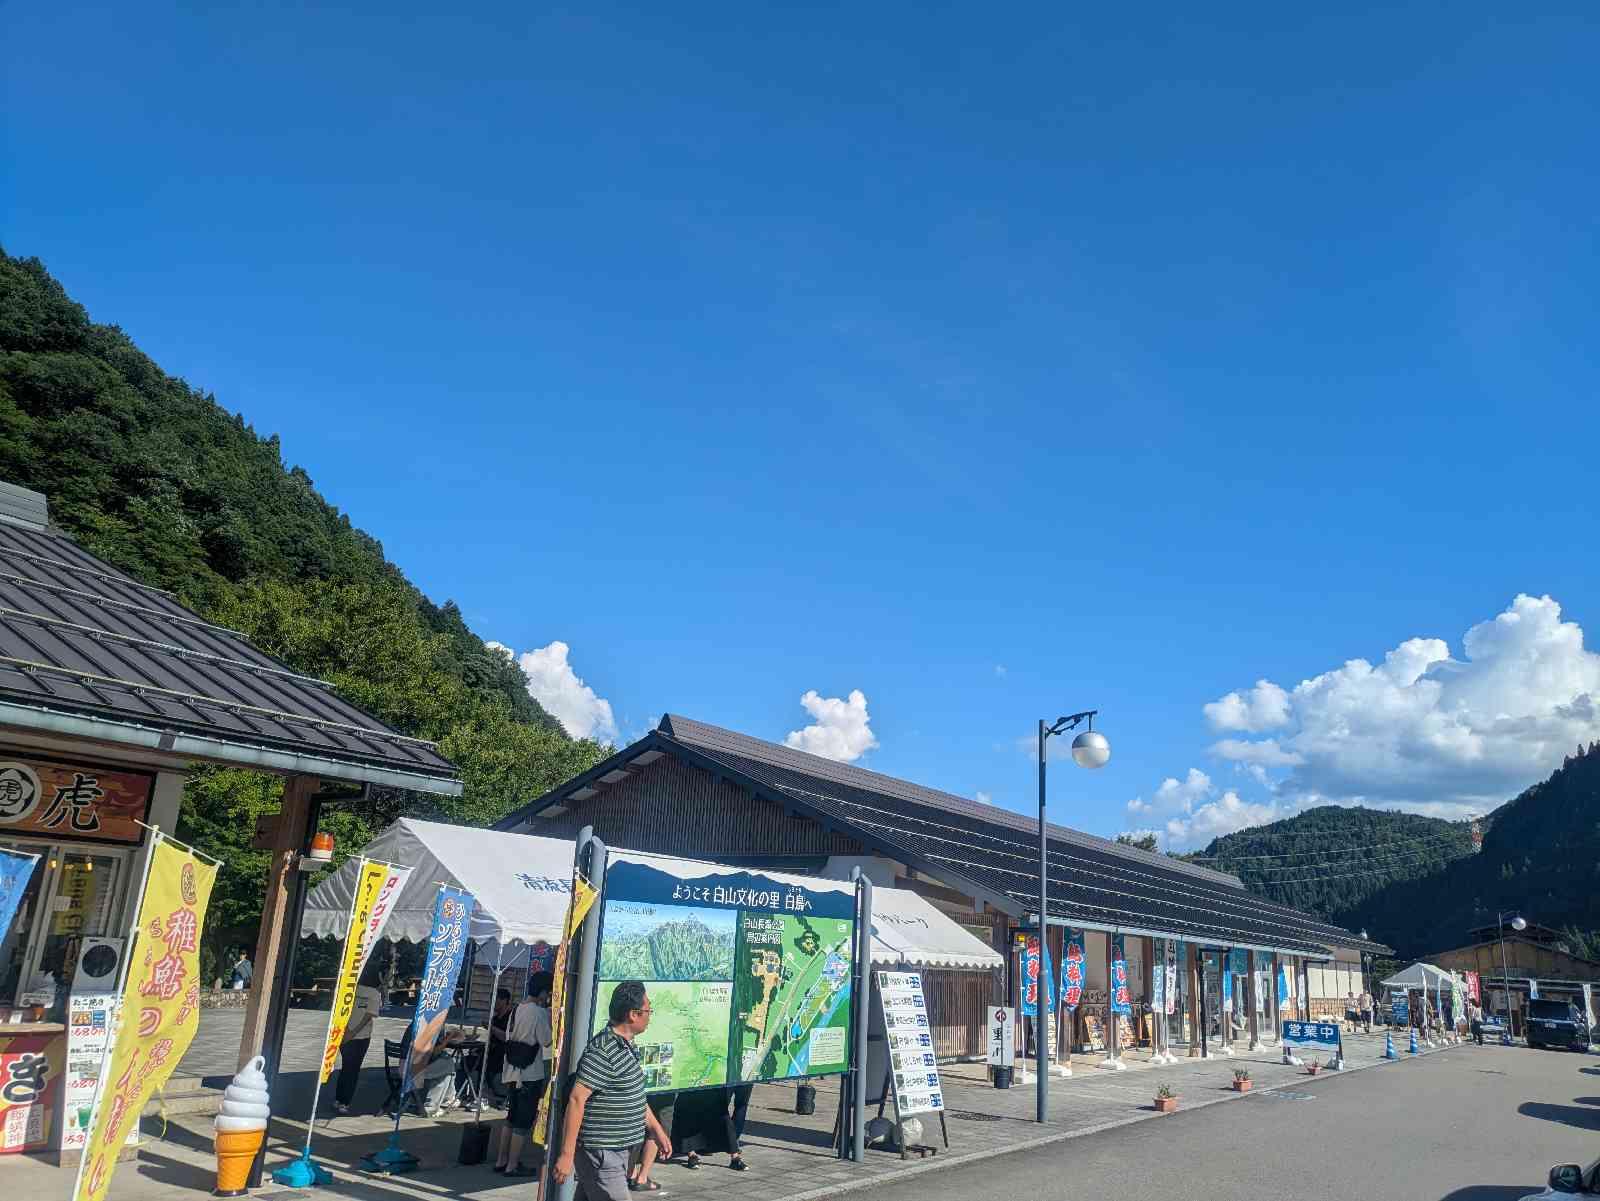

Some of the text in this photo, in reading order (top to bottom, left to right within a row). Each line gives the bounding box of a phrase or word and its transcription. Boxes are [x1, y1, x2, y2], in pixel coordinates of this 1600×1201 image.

[39, 774, 104, 831] 虎
[672, 885, 812, 911] ようこそ 白山文化の里 白鳥へ
[1288, 1023, 1335, 1039] 営業中
